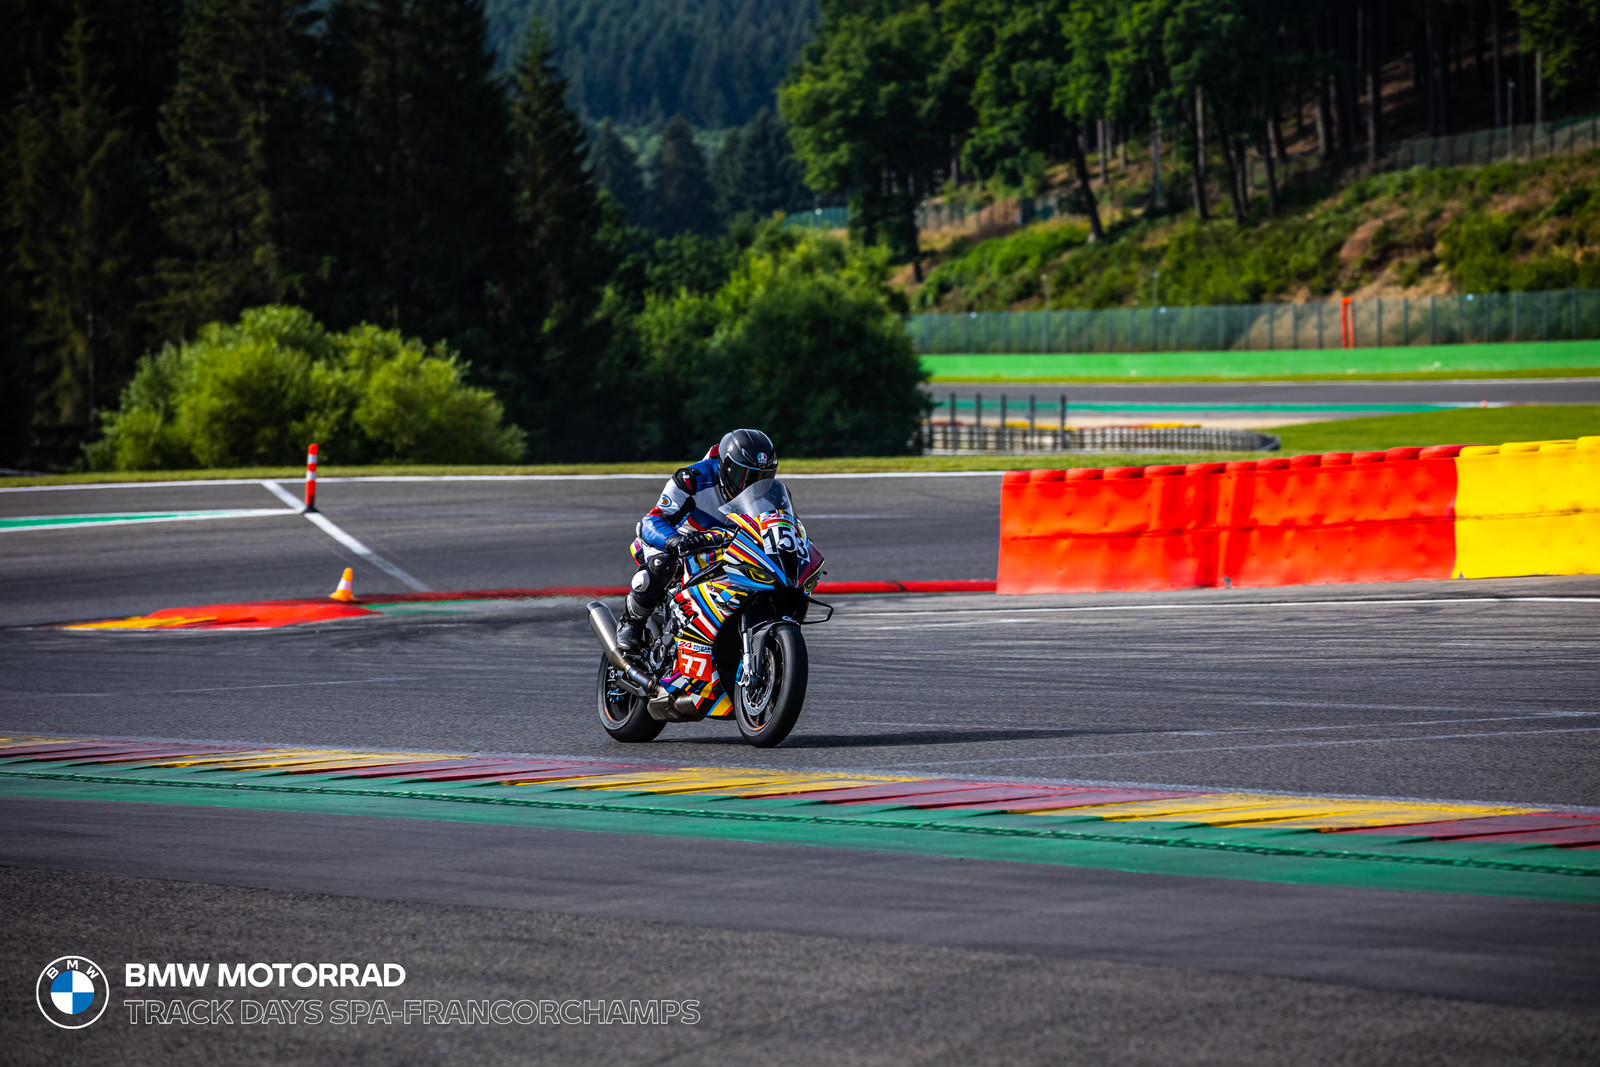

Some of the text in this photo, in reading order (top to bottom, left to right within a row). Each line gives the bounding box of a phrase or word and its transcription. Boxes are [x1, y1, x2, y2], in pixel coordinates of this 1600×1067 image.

[762, 526, 808, 559] 153
[678, 640, 693, 649] 24
[680, 654, 707, 678] 77
